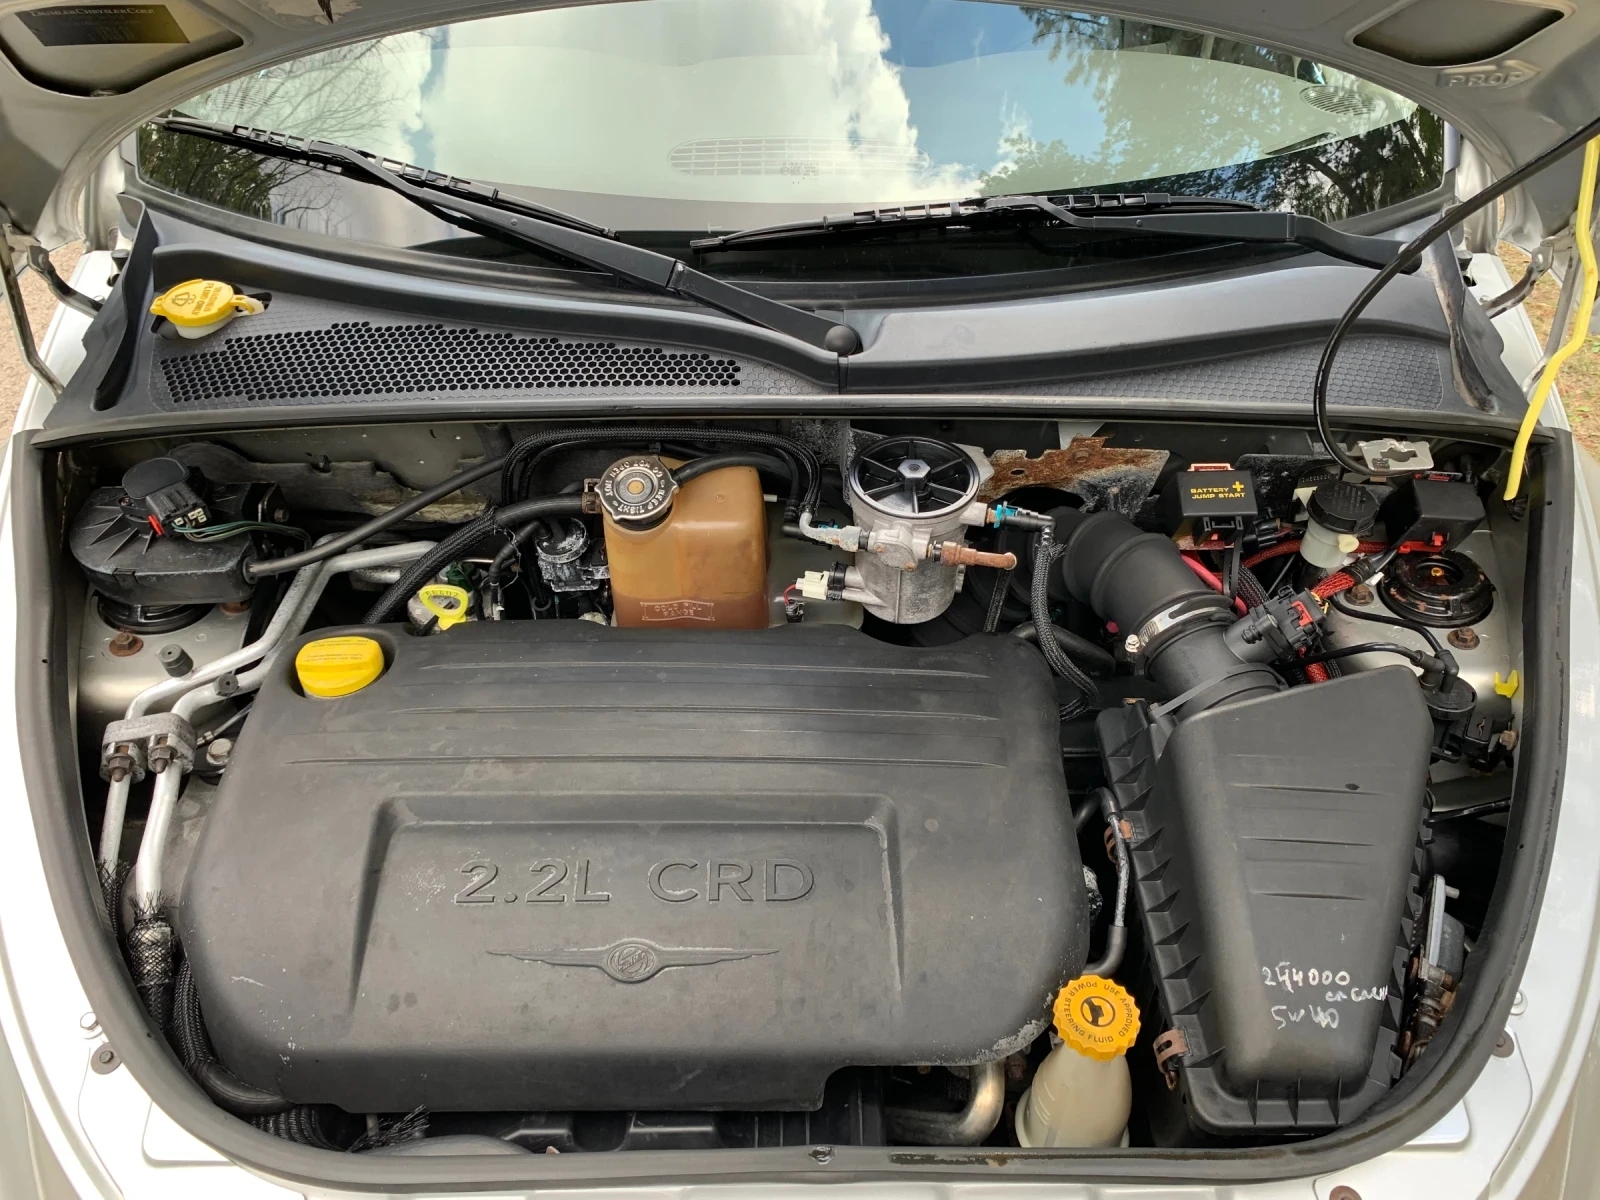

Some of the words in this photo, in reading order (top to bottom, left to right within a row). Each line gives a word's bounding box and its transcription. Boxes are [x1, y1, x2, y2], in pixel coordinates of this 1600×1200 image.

[1449, 71, 1522, 87] PROP
[199, 282, 215, 301] FLUID
[203, 286, 223, 313] WASHER
[191, 300, 206, 316] ONLY
[609, 461, 631, 478] OPEN
[1190, 487, 1229, 495] BATTERY
[647, 489, 666, 510] KEEP
[617, 504, 645, 515] TIGHT
[653, 603, 679, 613] COLD
[683, 602, 703, 611] FILL
[663, 608, 695, 618] RANGE
[454, 858, 611, 905] 2.2L
[647, 858, 816, 904] CRD
[1068, 981, 1098, 997] POWER
[1063, 997, 1086, 1037] STEERING
[1103, 983, 1121, 997] USE
[1118, 997, 1134, 1038] APPROVED
[1087, 1034, 1114, 1044] FLUID
